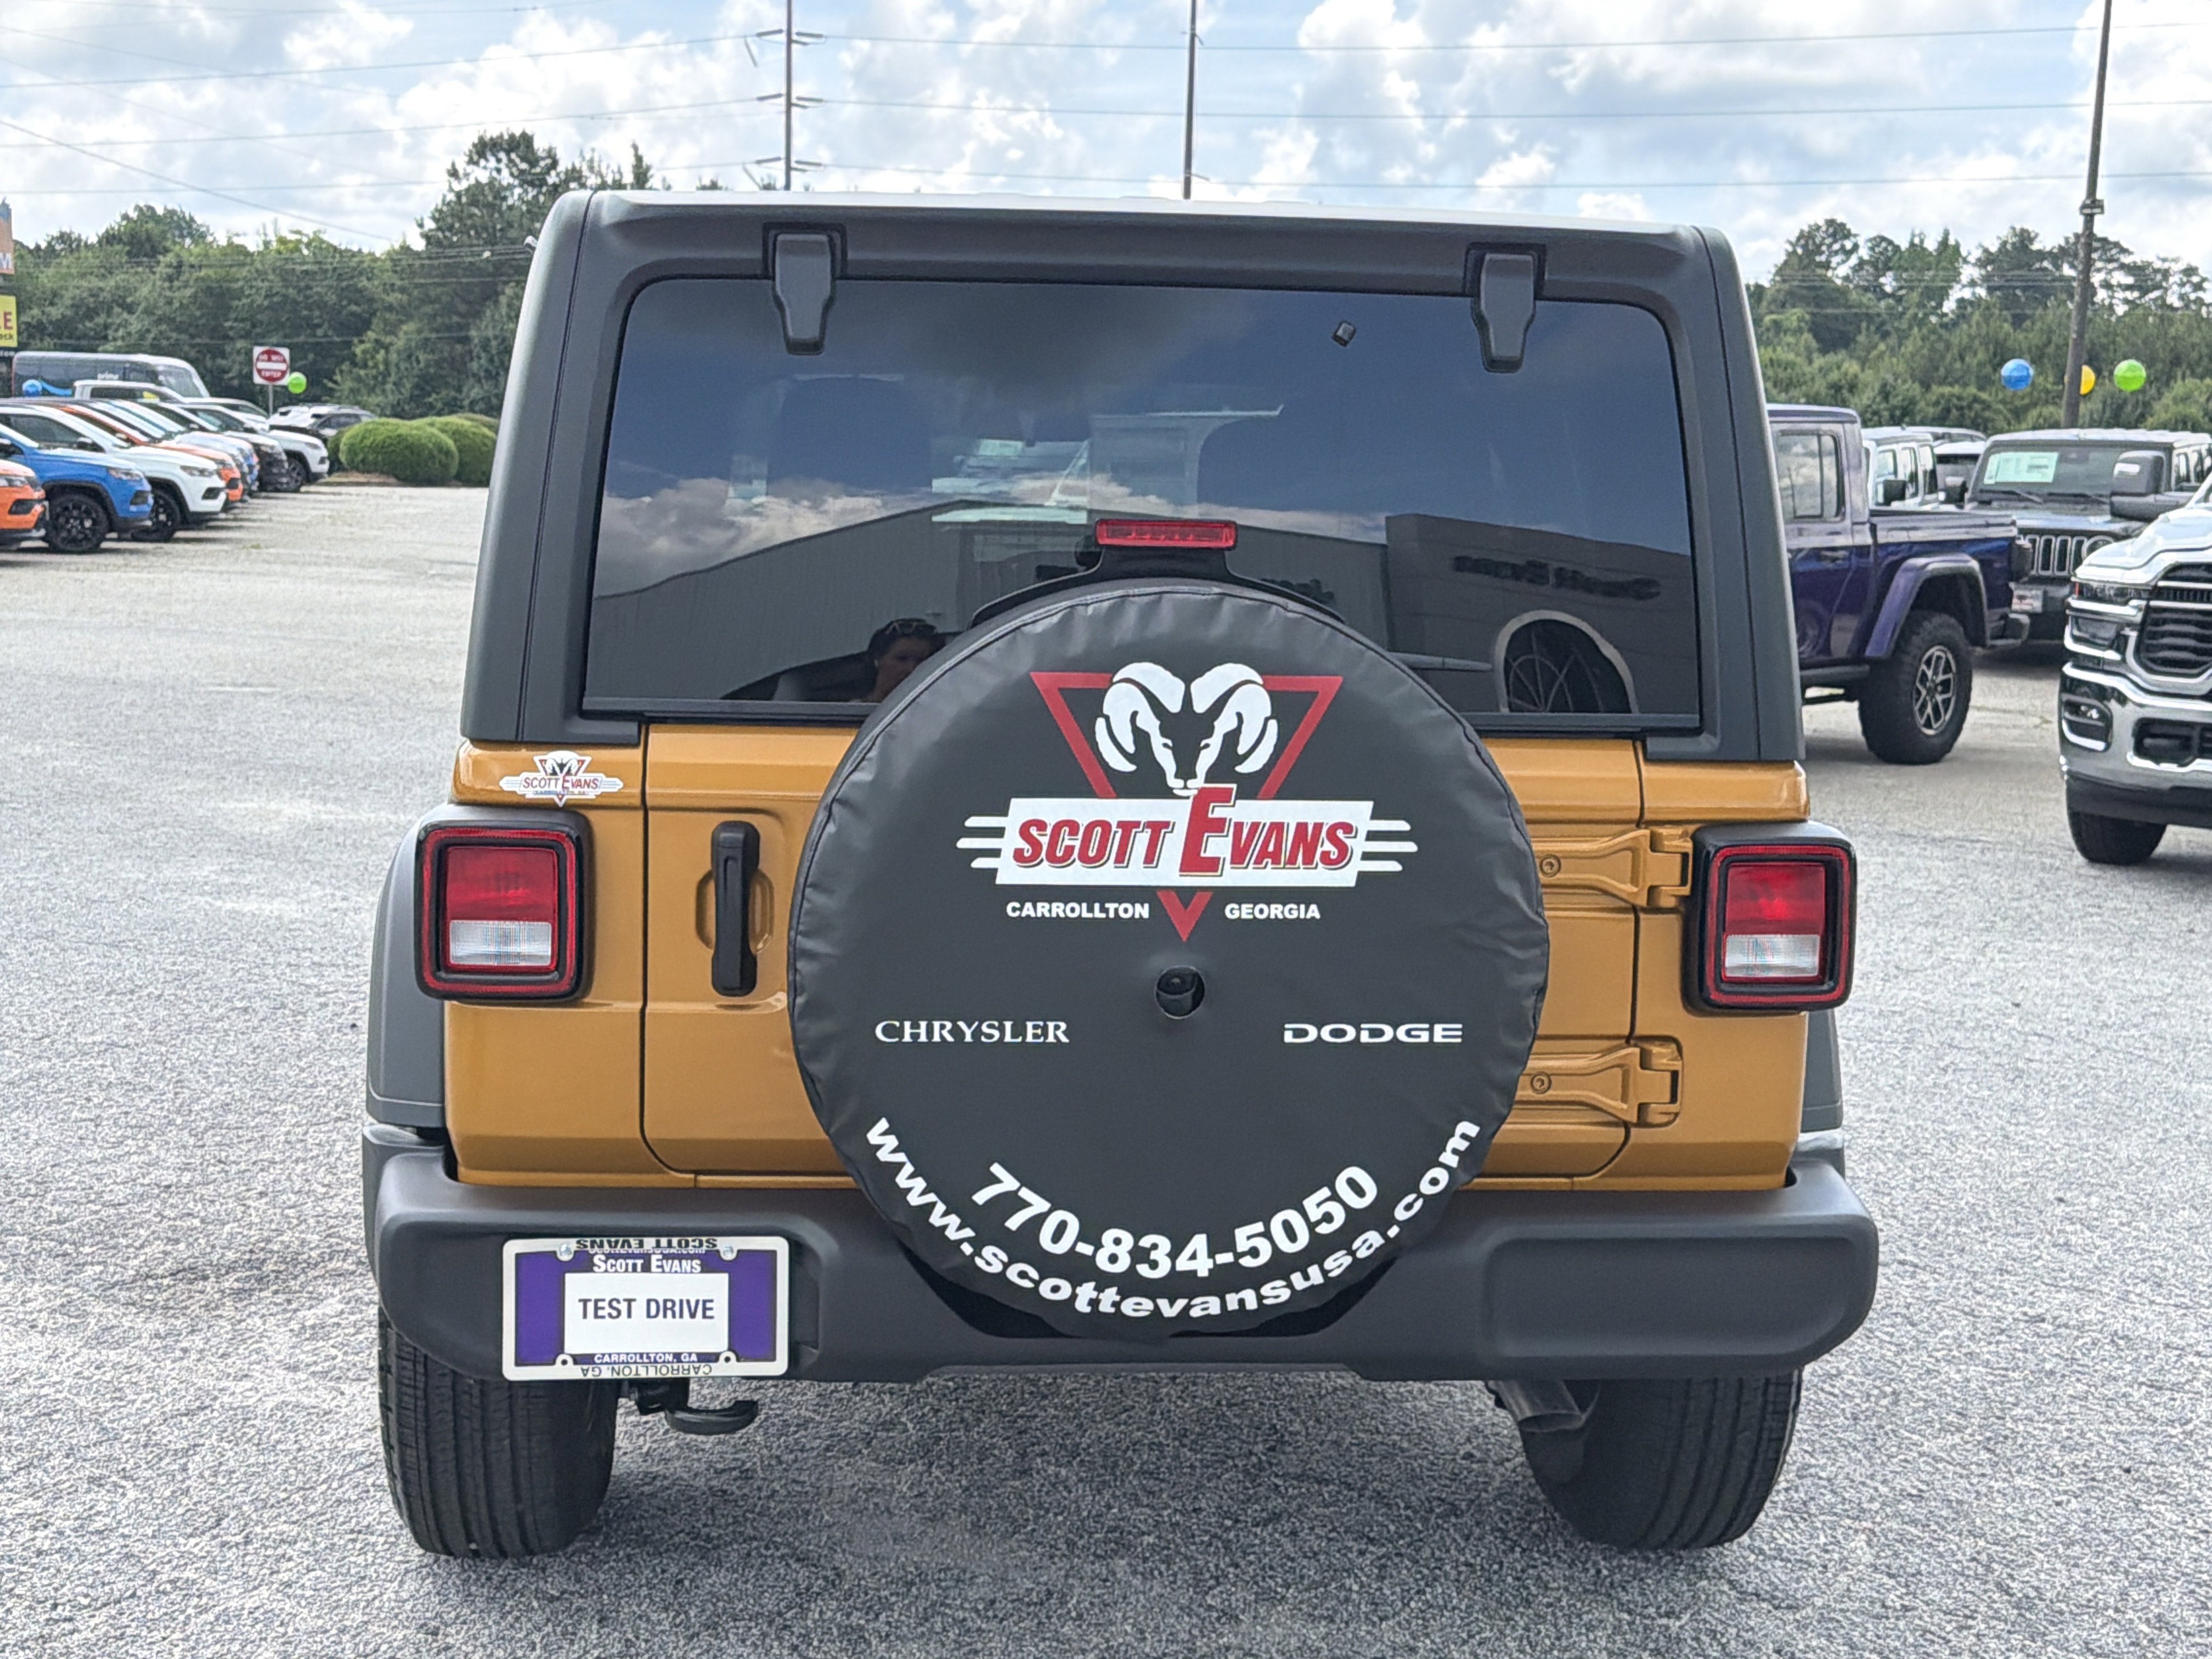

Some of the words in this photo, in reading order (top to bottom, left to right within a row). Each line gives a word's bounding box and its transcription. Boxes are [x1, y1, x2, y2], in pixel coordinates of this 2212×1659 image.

[523, 777, 560, 789] SCOTT
[561, 775, 600, 791] EVANS
[1012, 818, 1176, 868] SCOTT
[1179, 785, 1357, 877] EVANS
[1006, 901, 1150, 919] CARROLLTON
[1224, 902, 1321, 920] GEORGIA
[874, 1020, 1070, 1043] CHRYSLER
[1283, 1023, 1463, 1043] DODGE
[866, 1117, 1481, 1318] www.scottevansusa.com
[972, 1162, 1378, 1279] 770-834-5050
[575, 1238, 644, 1249] EVANS
[651, 1238, 718, 1249] SCOTT
[592, 1254, 644, 1273] SCOTT
[650, 1254, 702, 1273] EVANS
[578, 1298, 636, 1319] TEST
[646, 1298, 715, 1319] DRIVE
[680, 1353, 698, 1362] GA
[580, 1365, 602, 1378] GA
